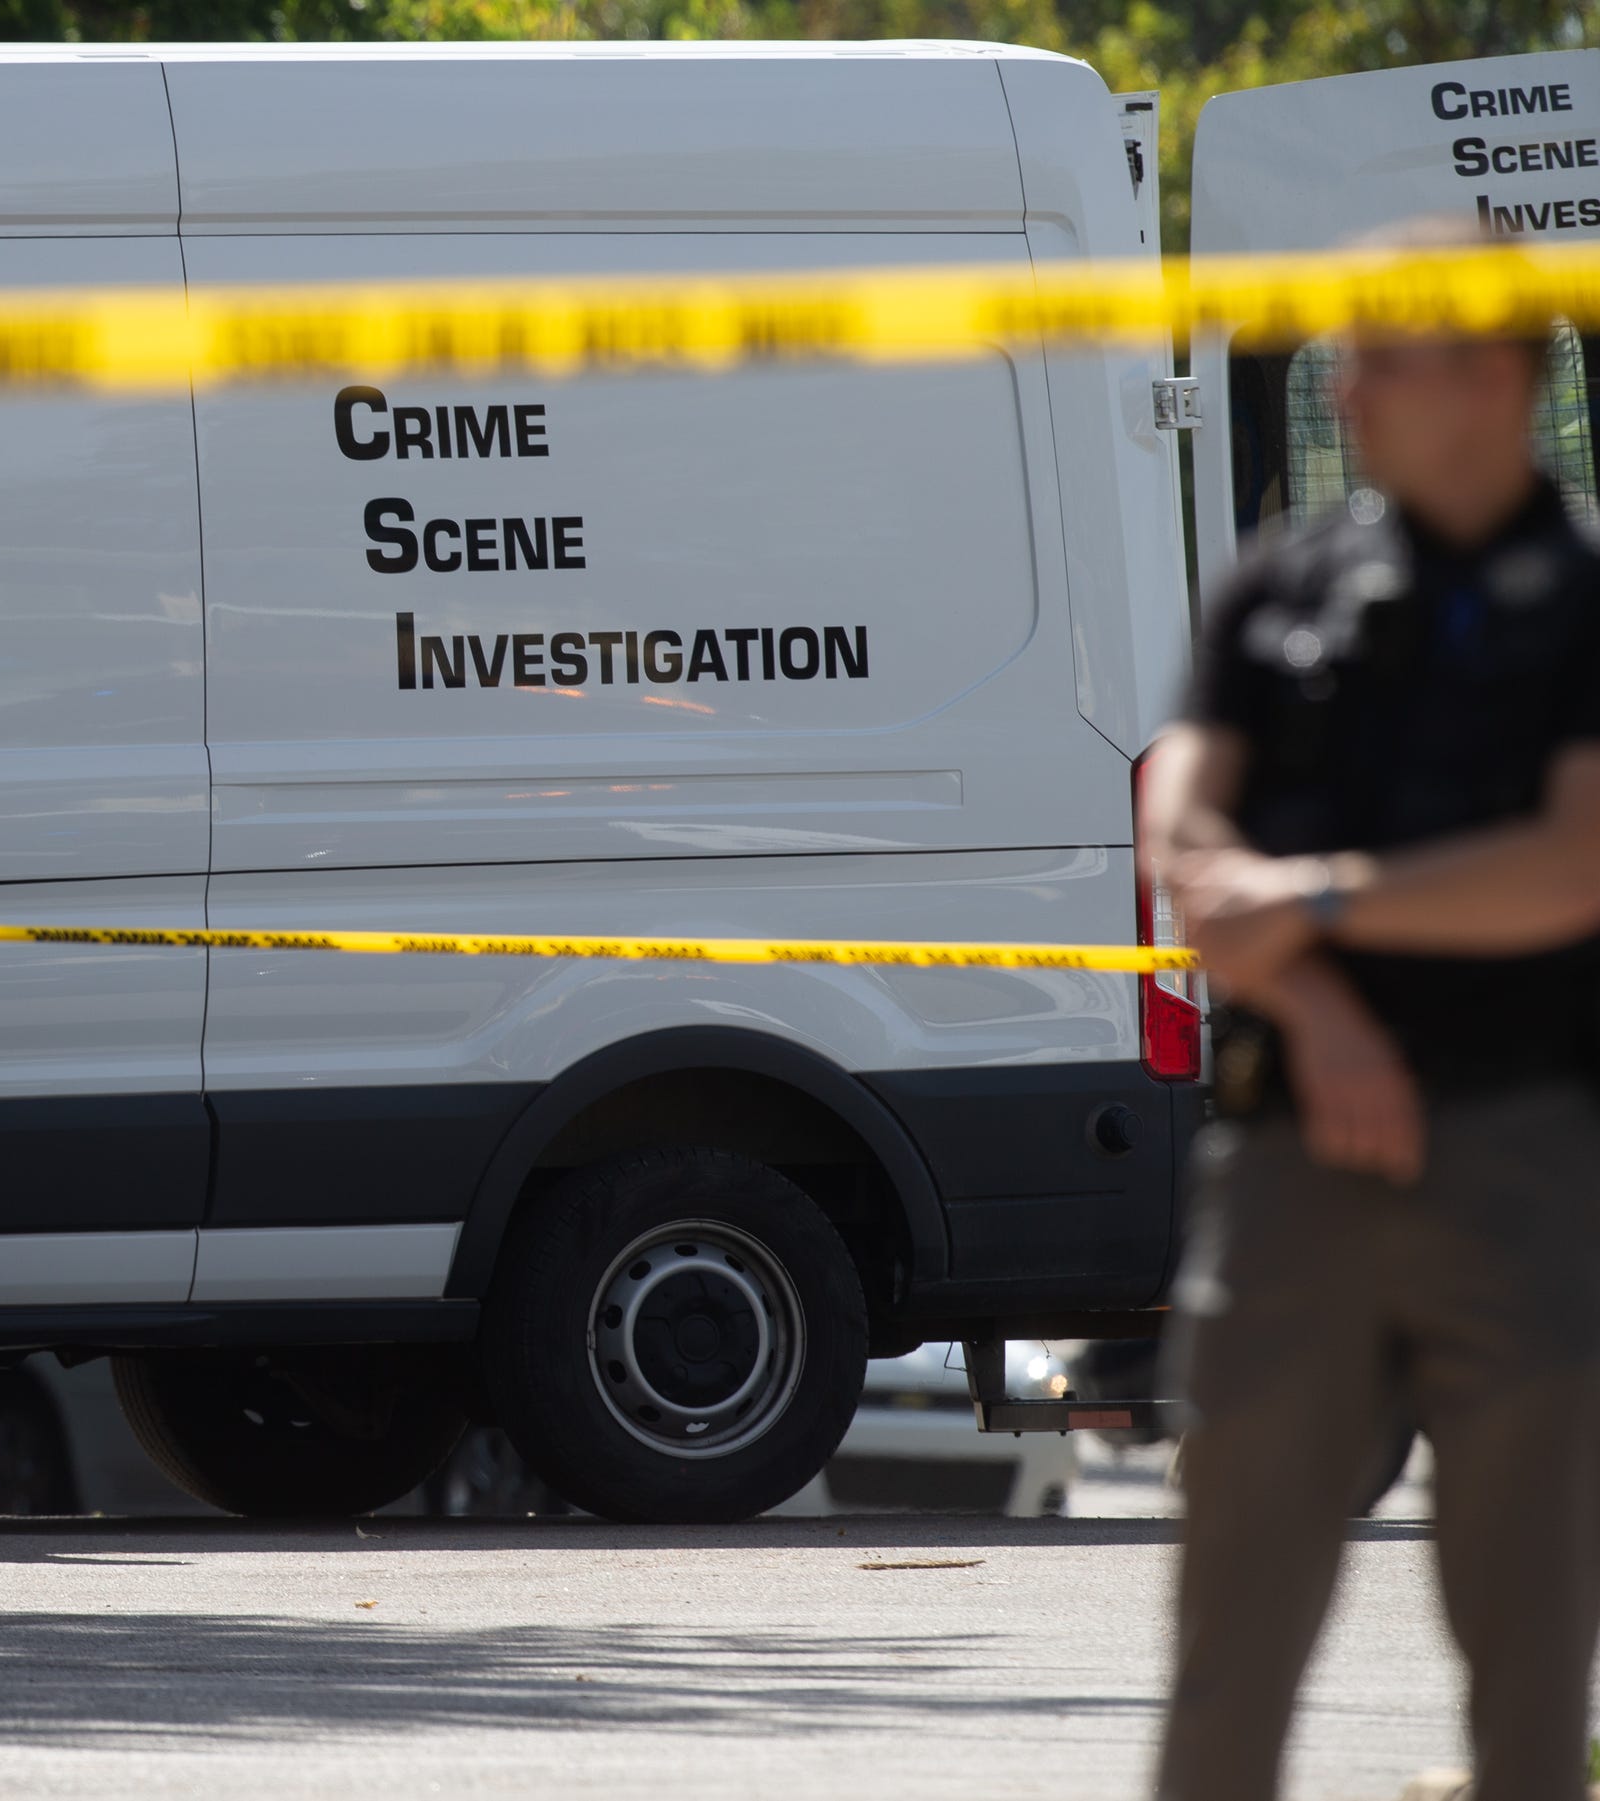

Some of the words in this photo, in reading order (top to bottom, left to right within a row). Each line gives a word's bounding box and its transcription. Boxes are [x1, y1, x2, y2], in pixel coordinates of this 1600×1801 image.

[1431, 81, 1573, 121] CRIME
[1452, 137, 1599, 177] SCENE
[334, 385, 550, 461] CRIME
[363, 497, 586, 574] SCENE
[396, 611, 869, 690] INVESTIGATION
